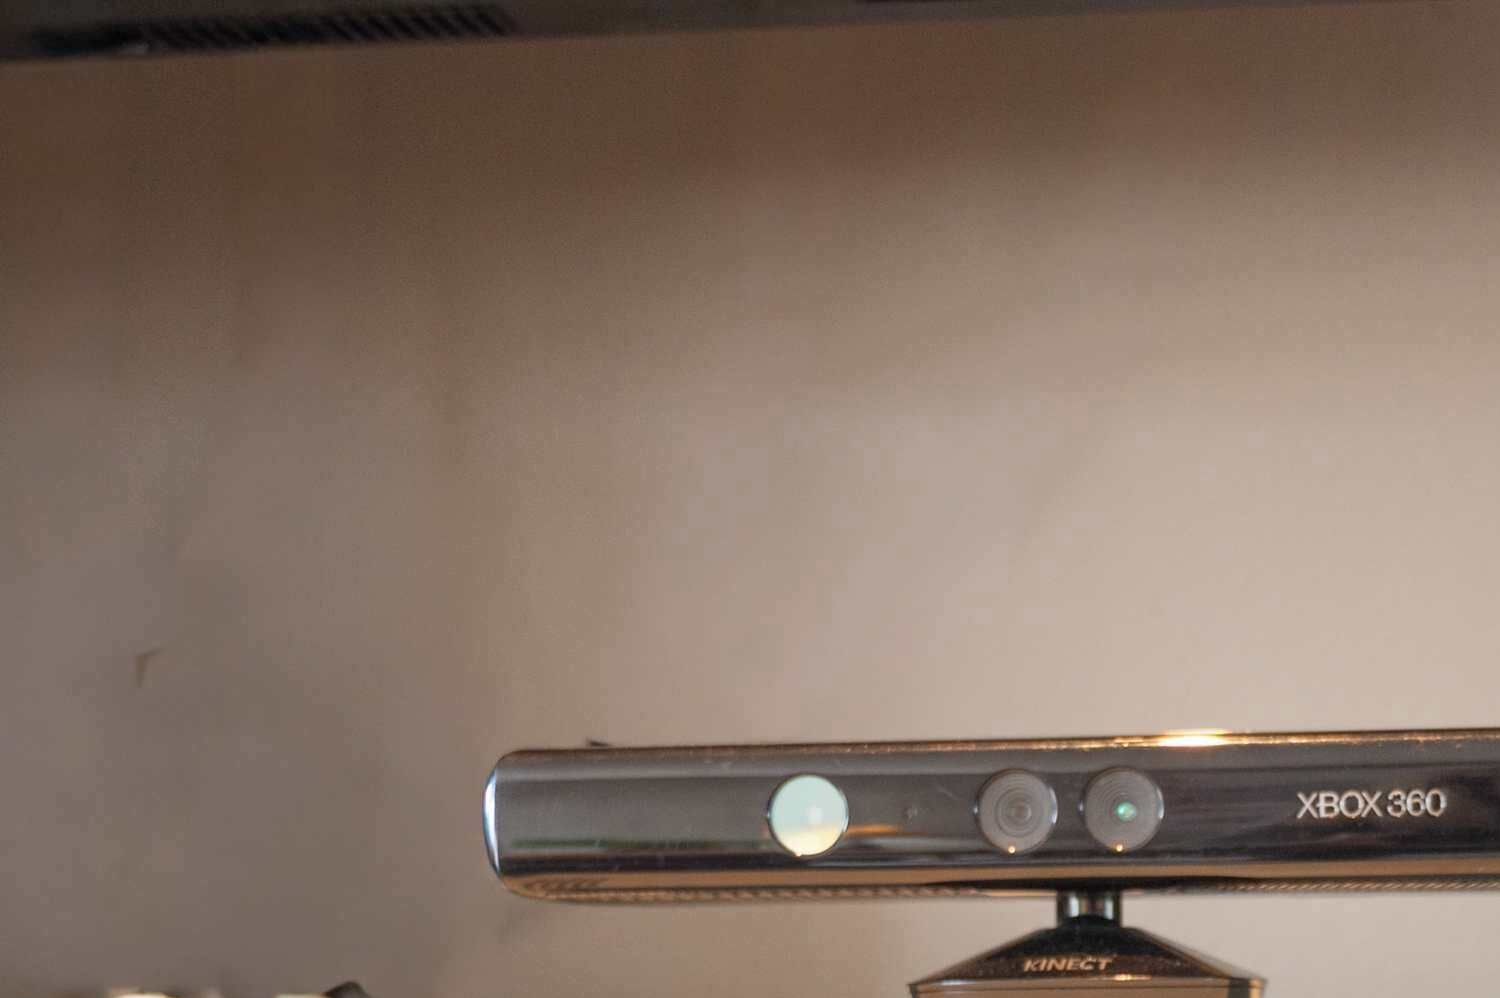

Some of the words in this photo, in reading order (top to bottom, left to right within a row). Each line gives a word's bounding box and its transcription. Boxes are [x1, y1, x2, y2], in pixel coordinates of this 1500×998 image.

[1297, 789, 1383, 819] XBOX
[1387, 788, 1448, 818] 360
[1023, 954, 1114, 973] KINECT
